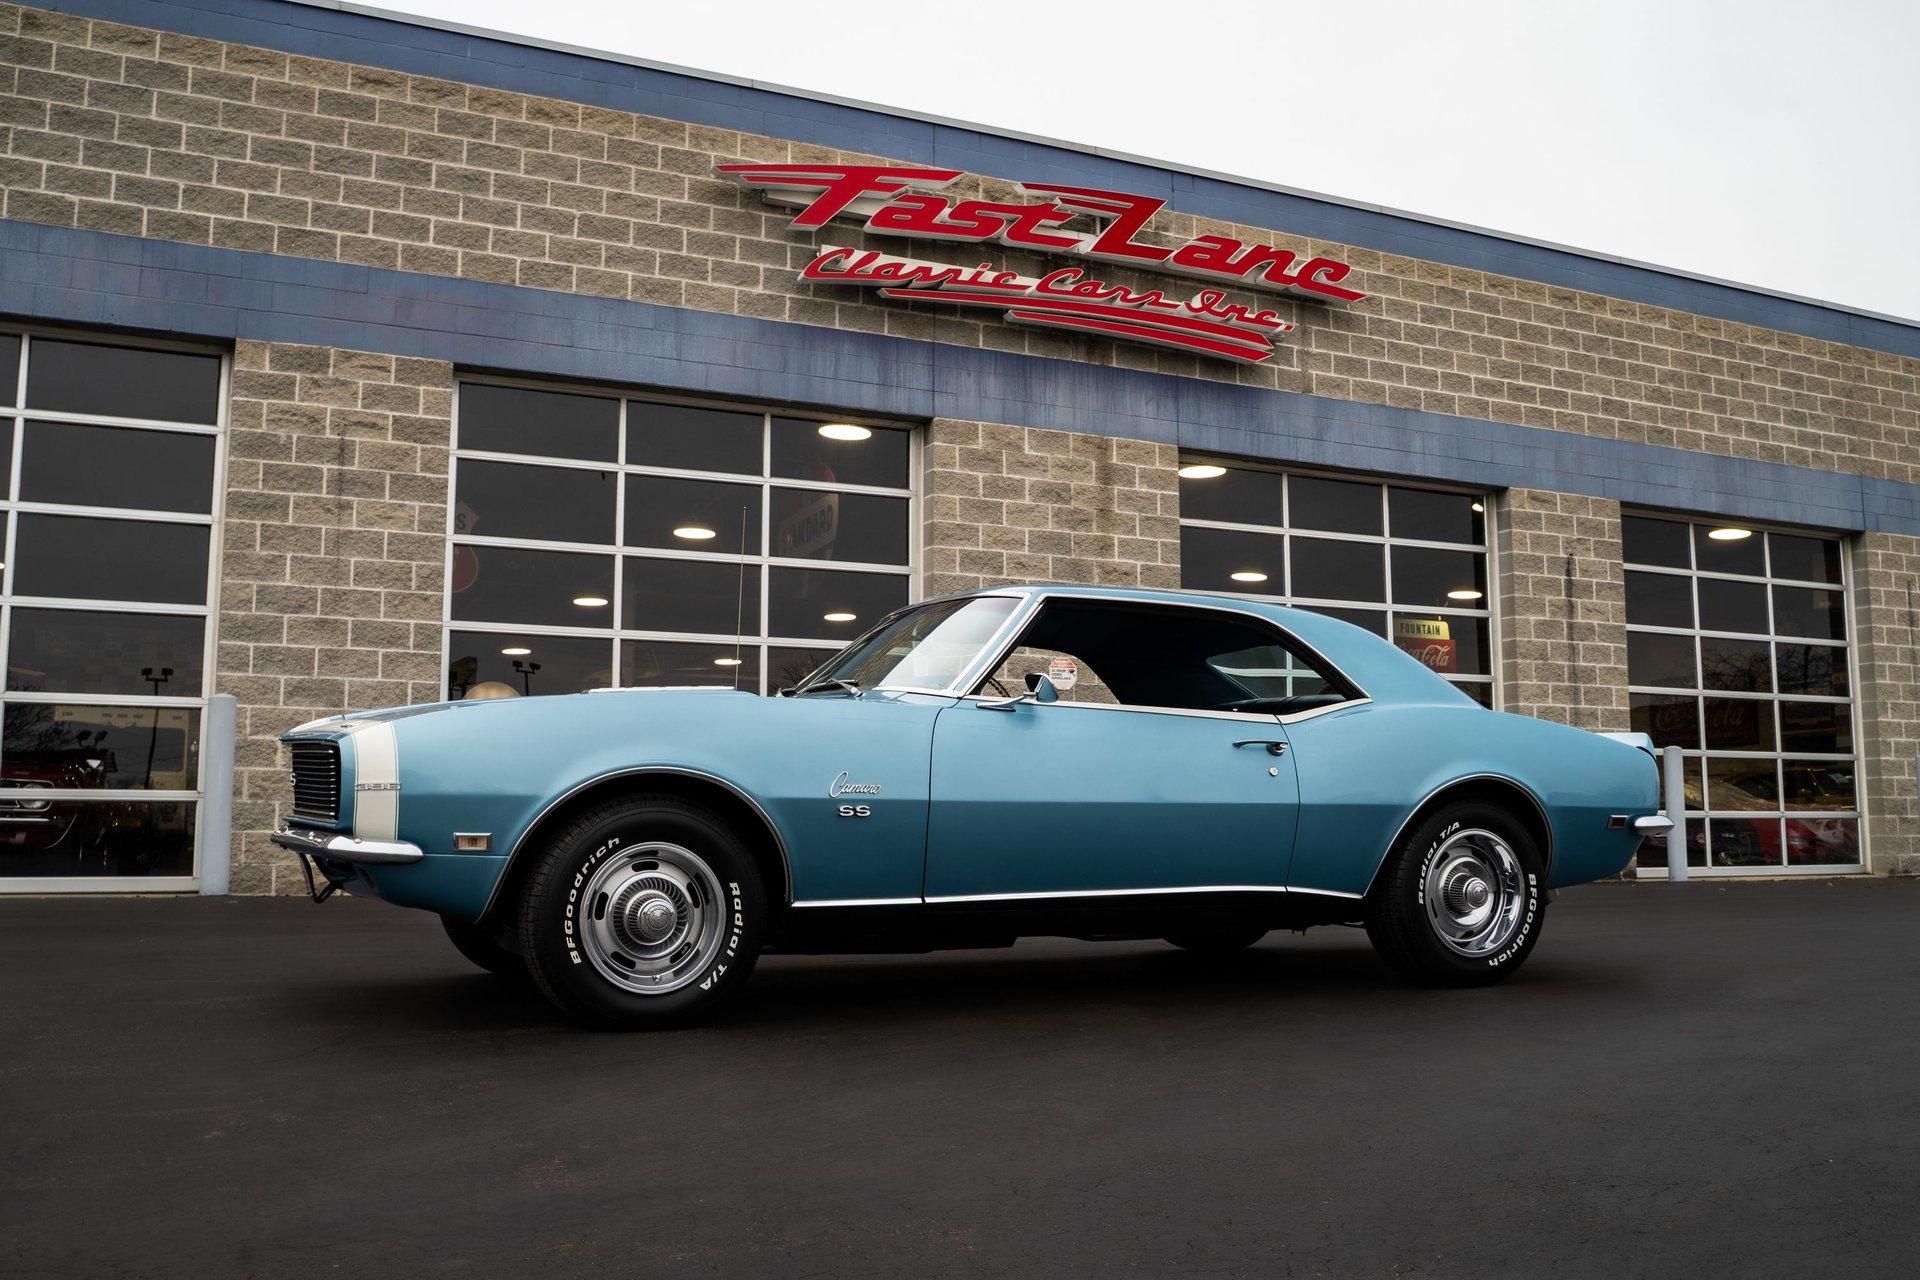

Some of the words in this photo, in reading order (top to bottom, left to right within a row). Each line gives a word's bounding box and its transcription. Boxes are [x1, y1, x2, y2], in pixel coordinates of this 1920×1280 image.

[714, 163, 1086, 250] Fast
[1018, 180, 1368, 302] Lane
[802, 247, 1034, 292] Classic
[1035, 267, 1182, 310] Cars
[1184, 288, 1297, 332] Inc.
[1400, 623, 1441, 636] FOUNTAIN
[829, 770, 882, 798] Camaro
[838, 805, 871, 817] SS
[564, 836, 621, 965] BFGoodrich
[1418, 841, 1438, 905] Radial
[1439, 821, 1461, 839] T/A
[726, 882, 744, 957] Radial
[1488, 873, 1538, 967] BFGoodrich
[699, 963, 728, 991] T/A
